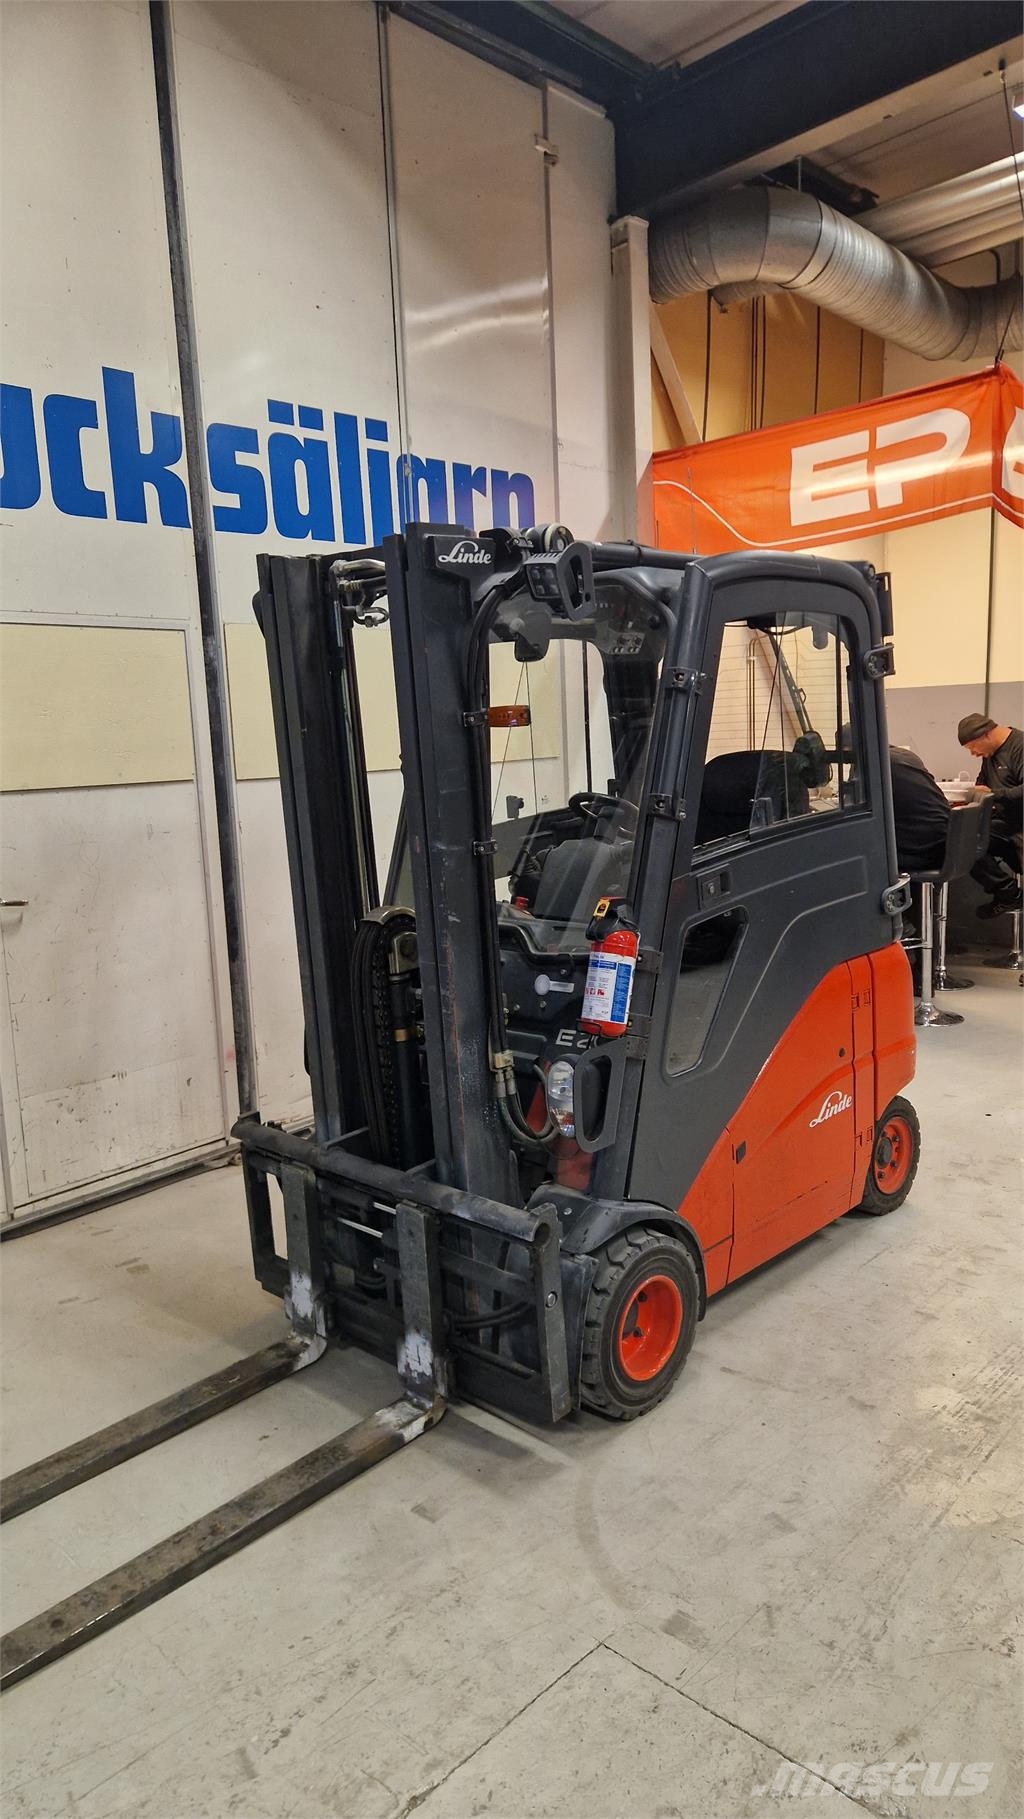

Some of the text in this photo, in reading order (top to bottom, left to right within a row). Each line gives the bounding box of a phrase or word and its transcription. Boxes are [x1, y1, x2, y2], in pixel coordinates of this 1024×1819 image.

[789, 407, 971, 527] EP
[438, 540, 493, 565] Linde
[809, 1090, 853, 1128] Linde
